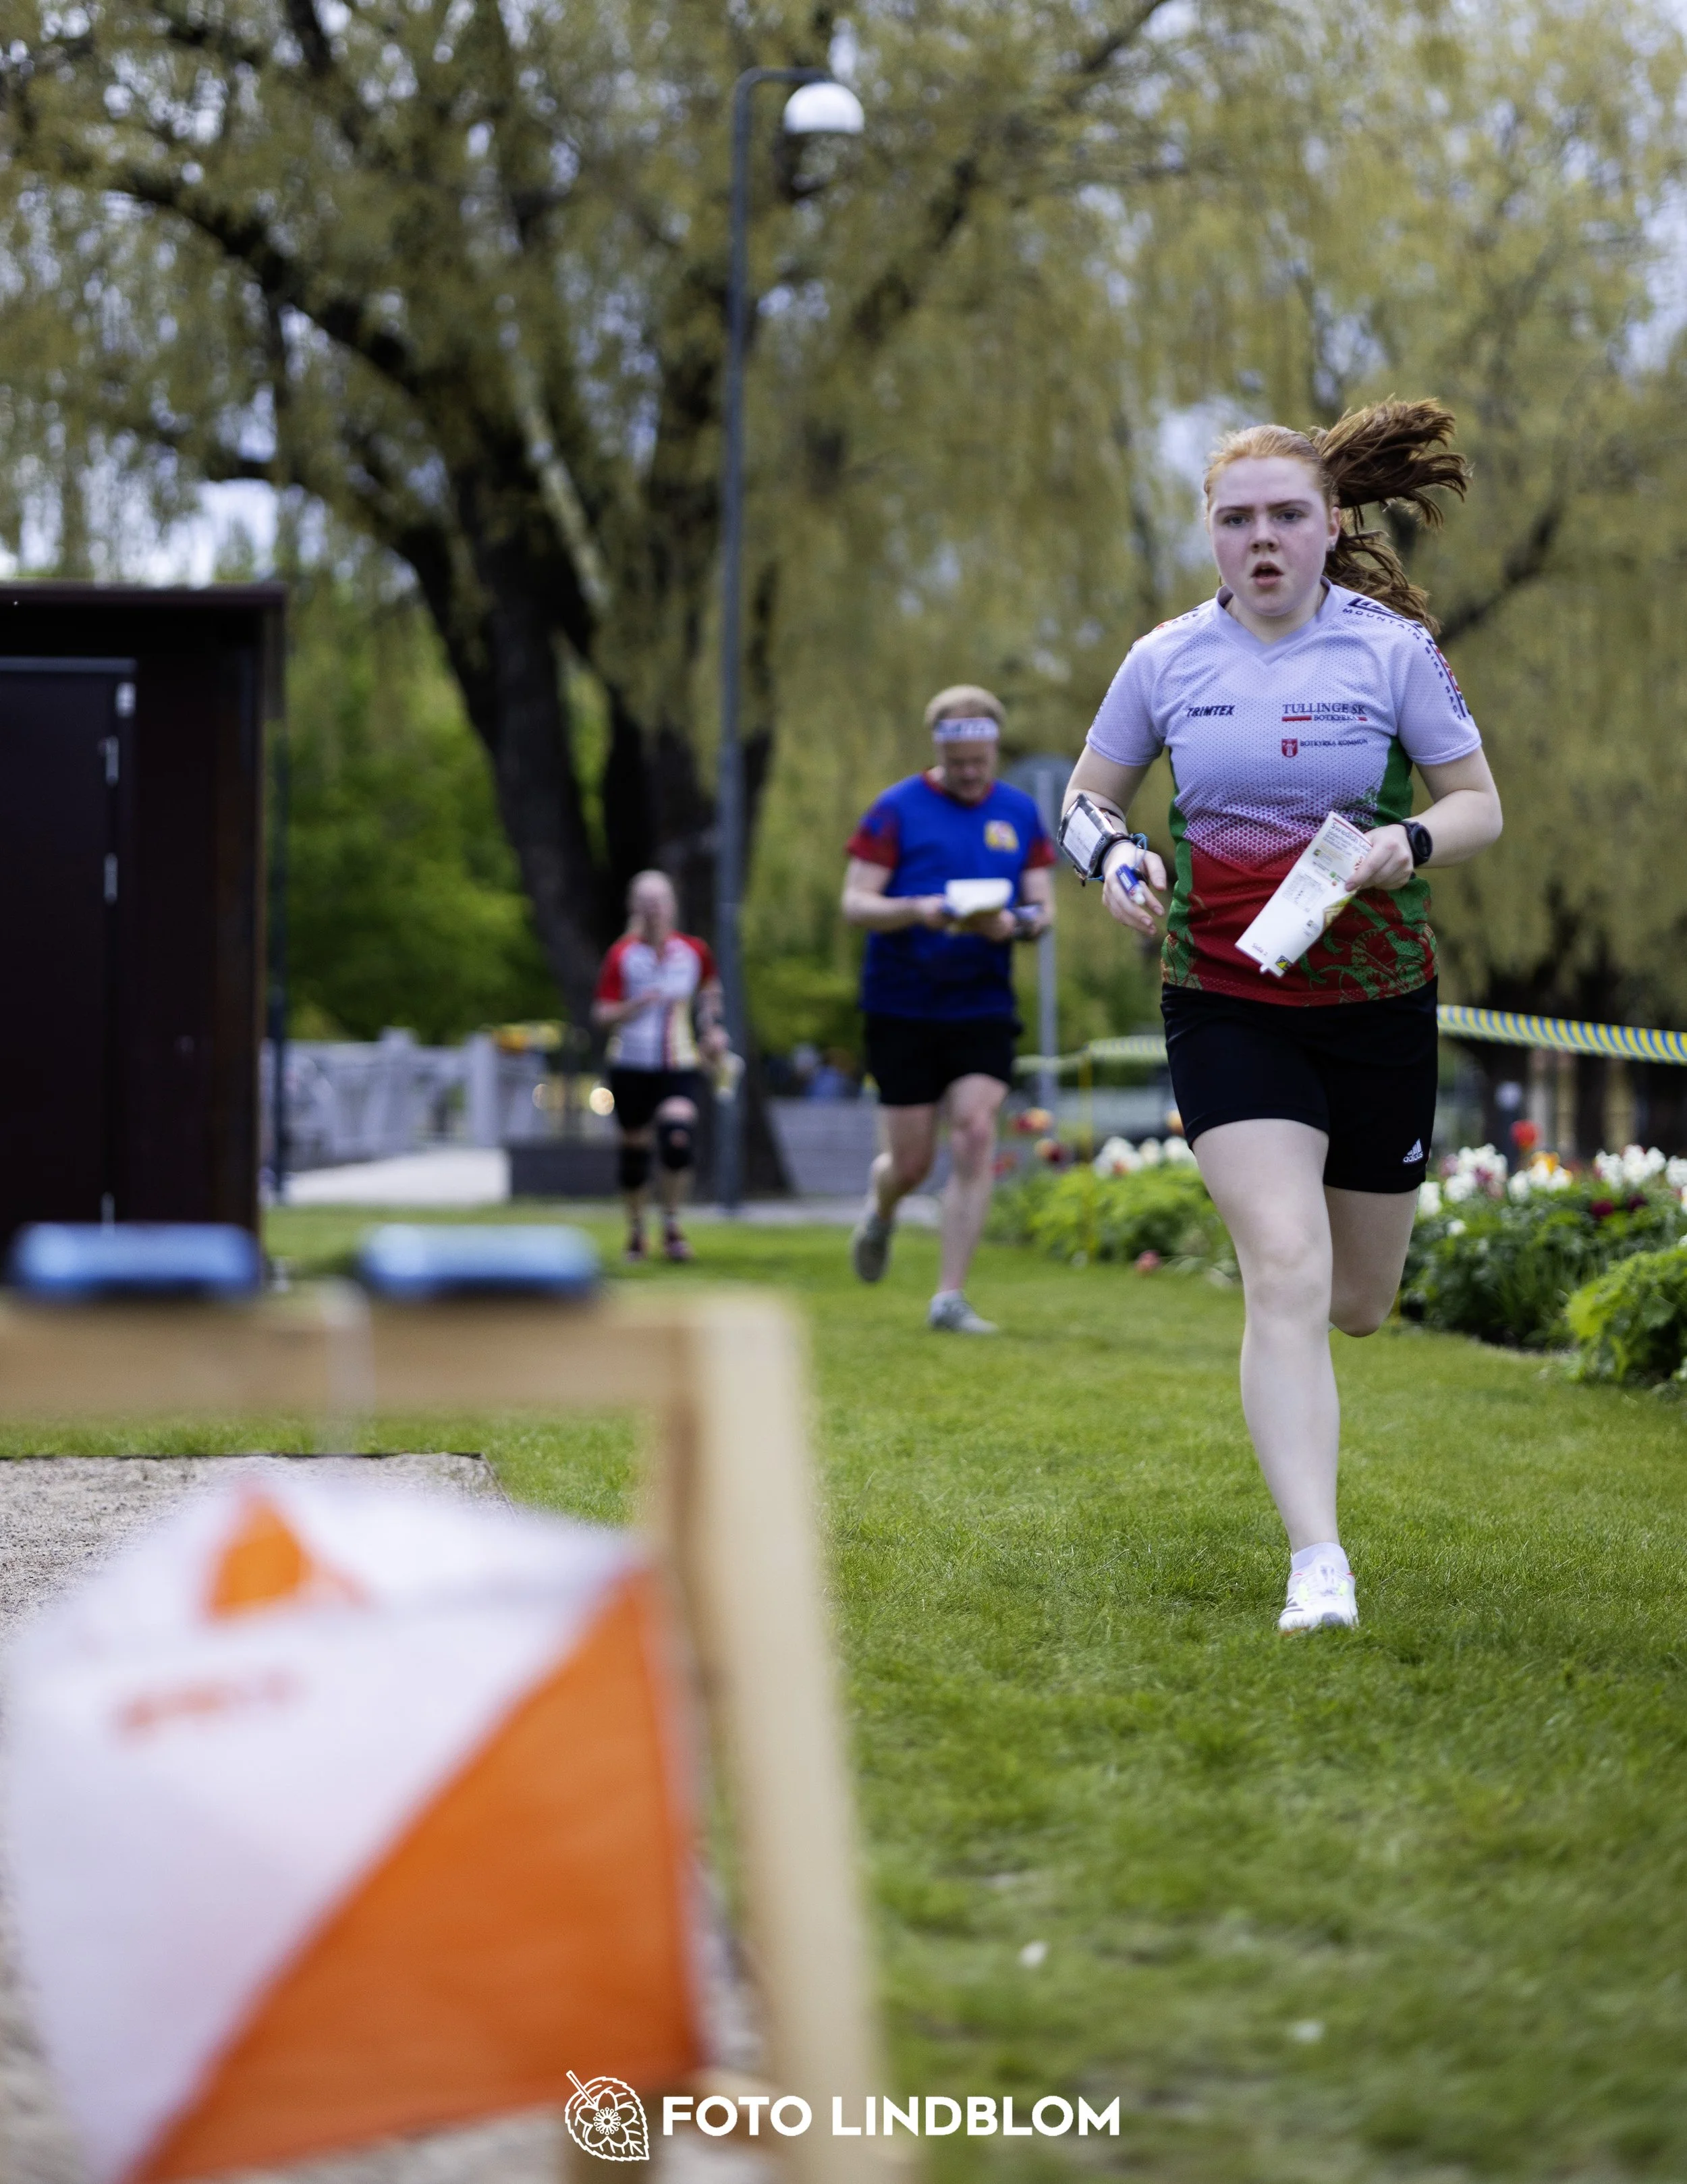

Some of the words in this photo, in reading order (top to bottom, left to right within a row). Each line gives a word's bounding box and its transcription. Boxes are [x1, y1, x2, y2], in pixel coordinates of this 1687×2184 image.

[1187, 705, 1236, 717] TRIMTEX
[1283, 703, 1349, 713] TULLINGE
[1351, 704, 1366, 714] SK
[1403, 1151, 1423, 1162] adidas
